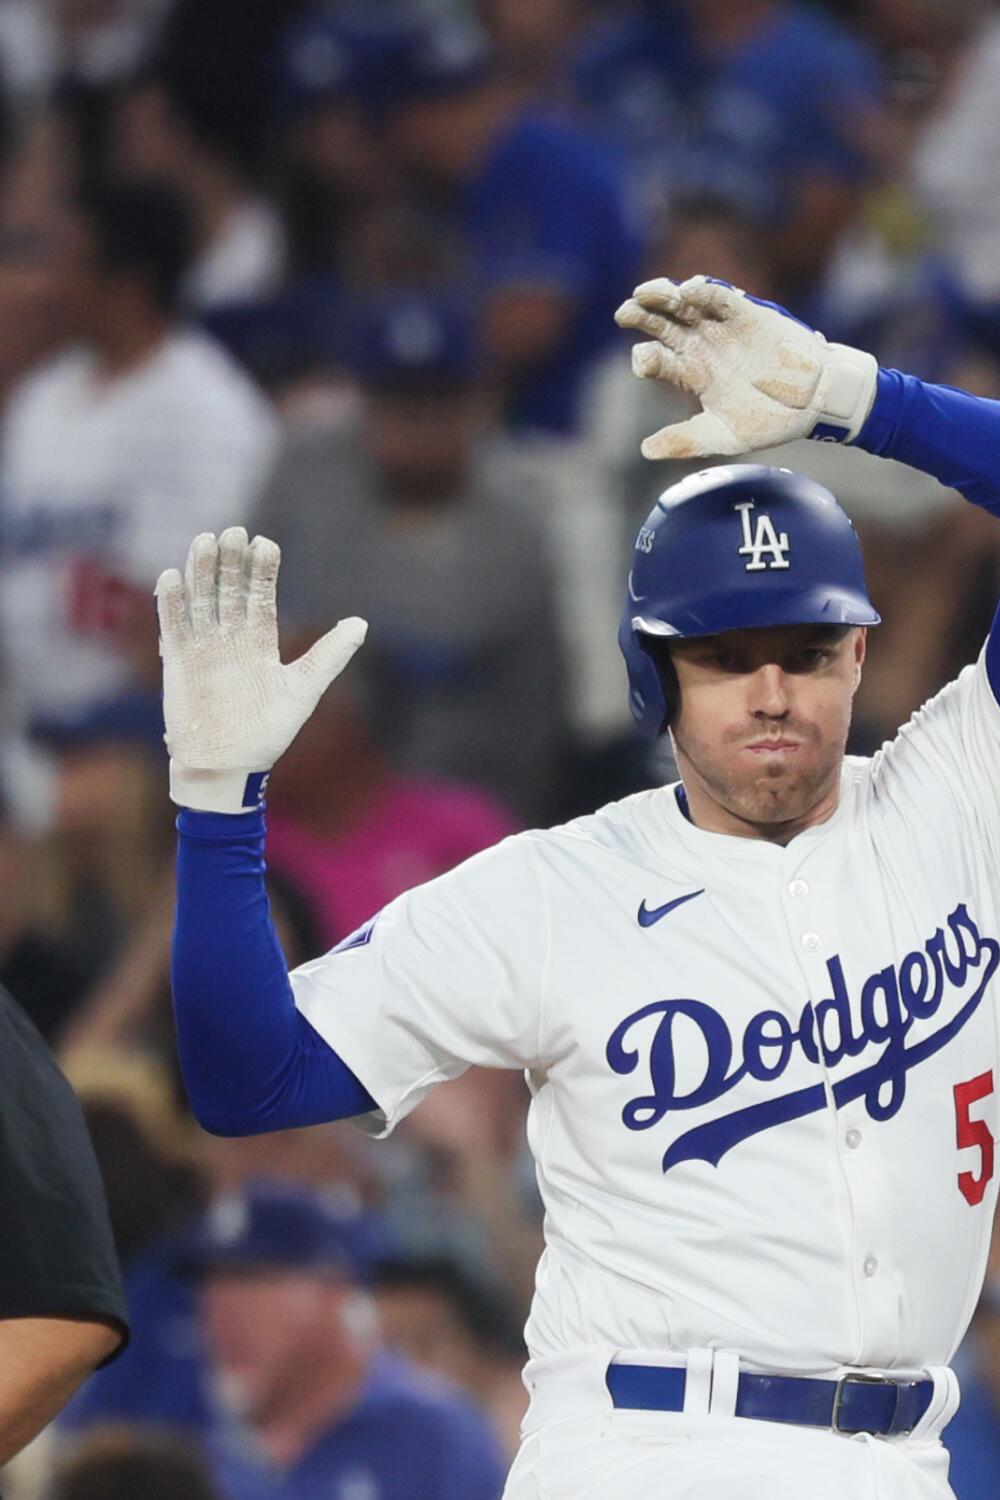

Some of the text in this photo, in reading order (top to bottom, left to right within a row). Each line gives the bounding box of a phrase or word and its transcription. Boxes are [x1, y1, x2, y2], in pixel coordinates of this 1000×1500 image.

[735, 501, 790, 570] LA
[606, 903, 1000, 1133] Dodgers
[953, 1069, 995, 1207] 5
